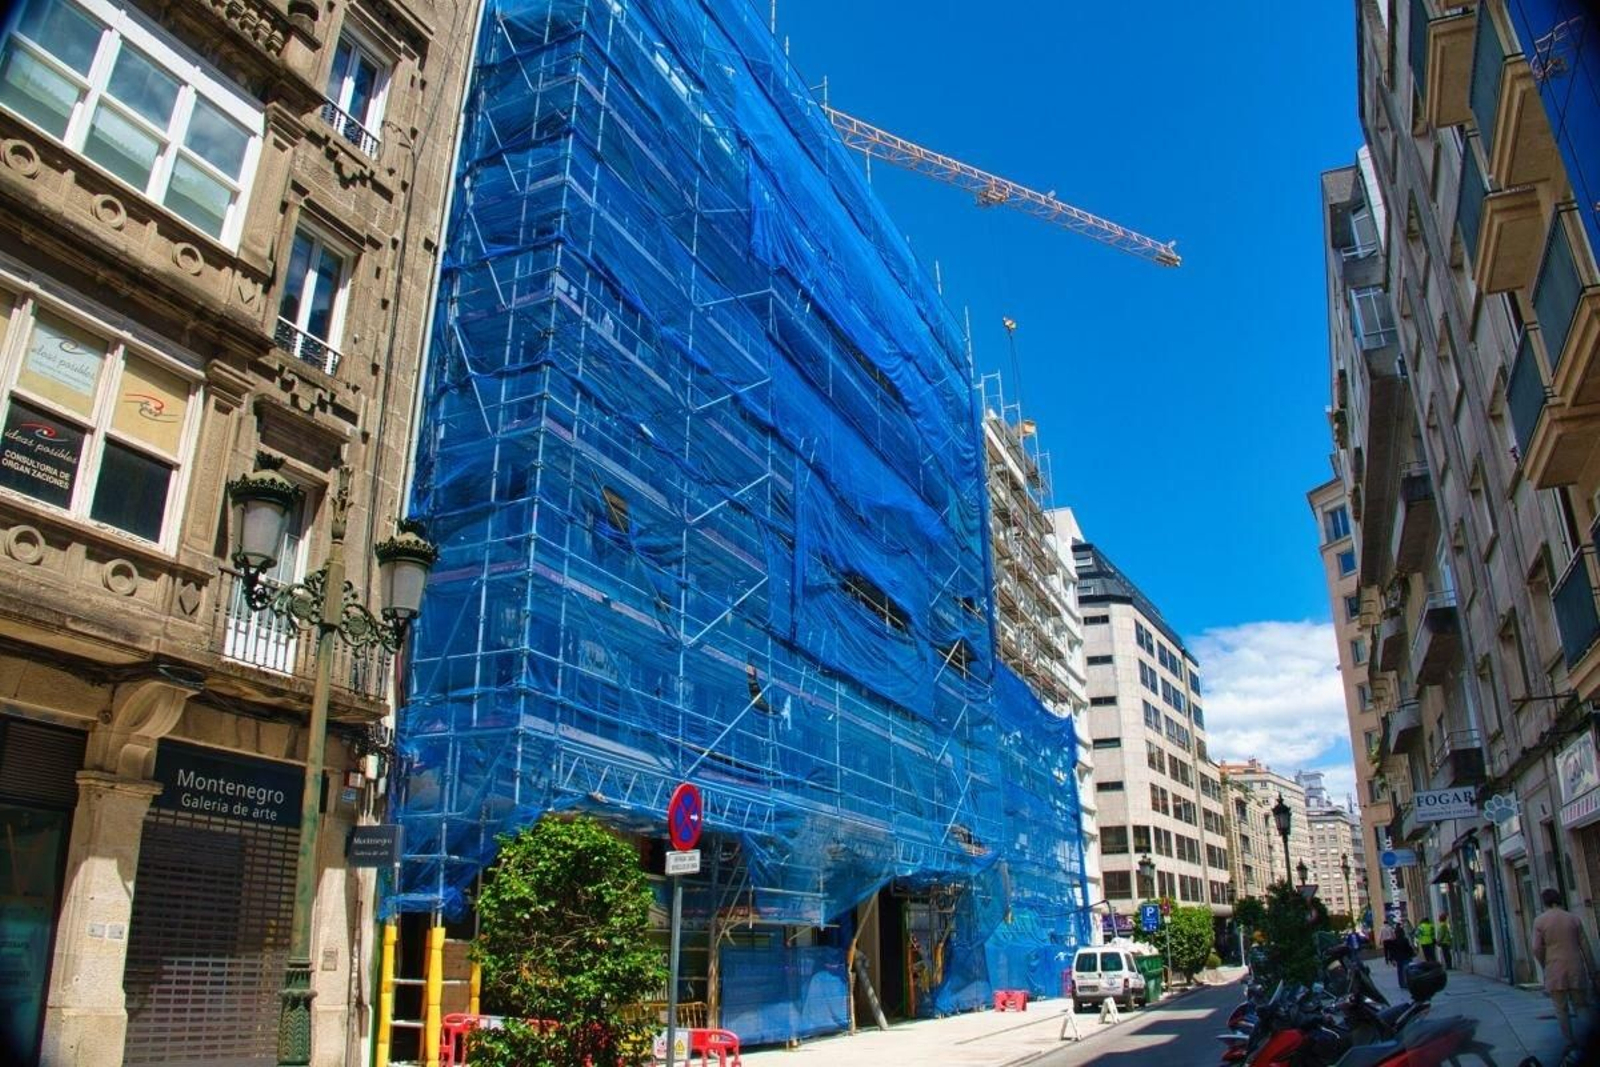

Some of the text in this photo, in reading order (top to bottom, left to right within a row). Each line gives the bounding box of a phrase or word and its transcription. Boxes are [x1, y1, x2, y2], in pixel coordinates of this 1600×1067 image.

[5, 429, 77, 464] ideas posibles
[1, 457, 69, 489] ORGANZACIONES
[59, 471, 70, 480] DE
[177, 769, 284, 804] Montenegro
[1416, 791, 1473, 807] FOGAR
[233, 803, 248, 816] de
[253, 807, 277, 820] arte
[1146, 906, 1155, 917] P
